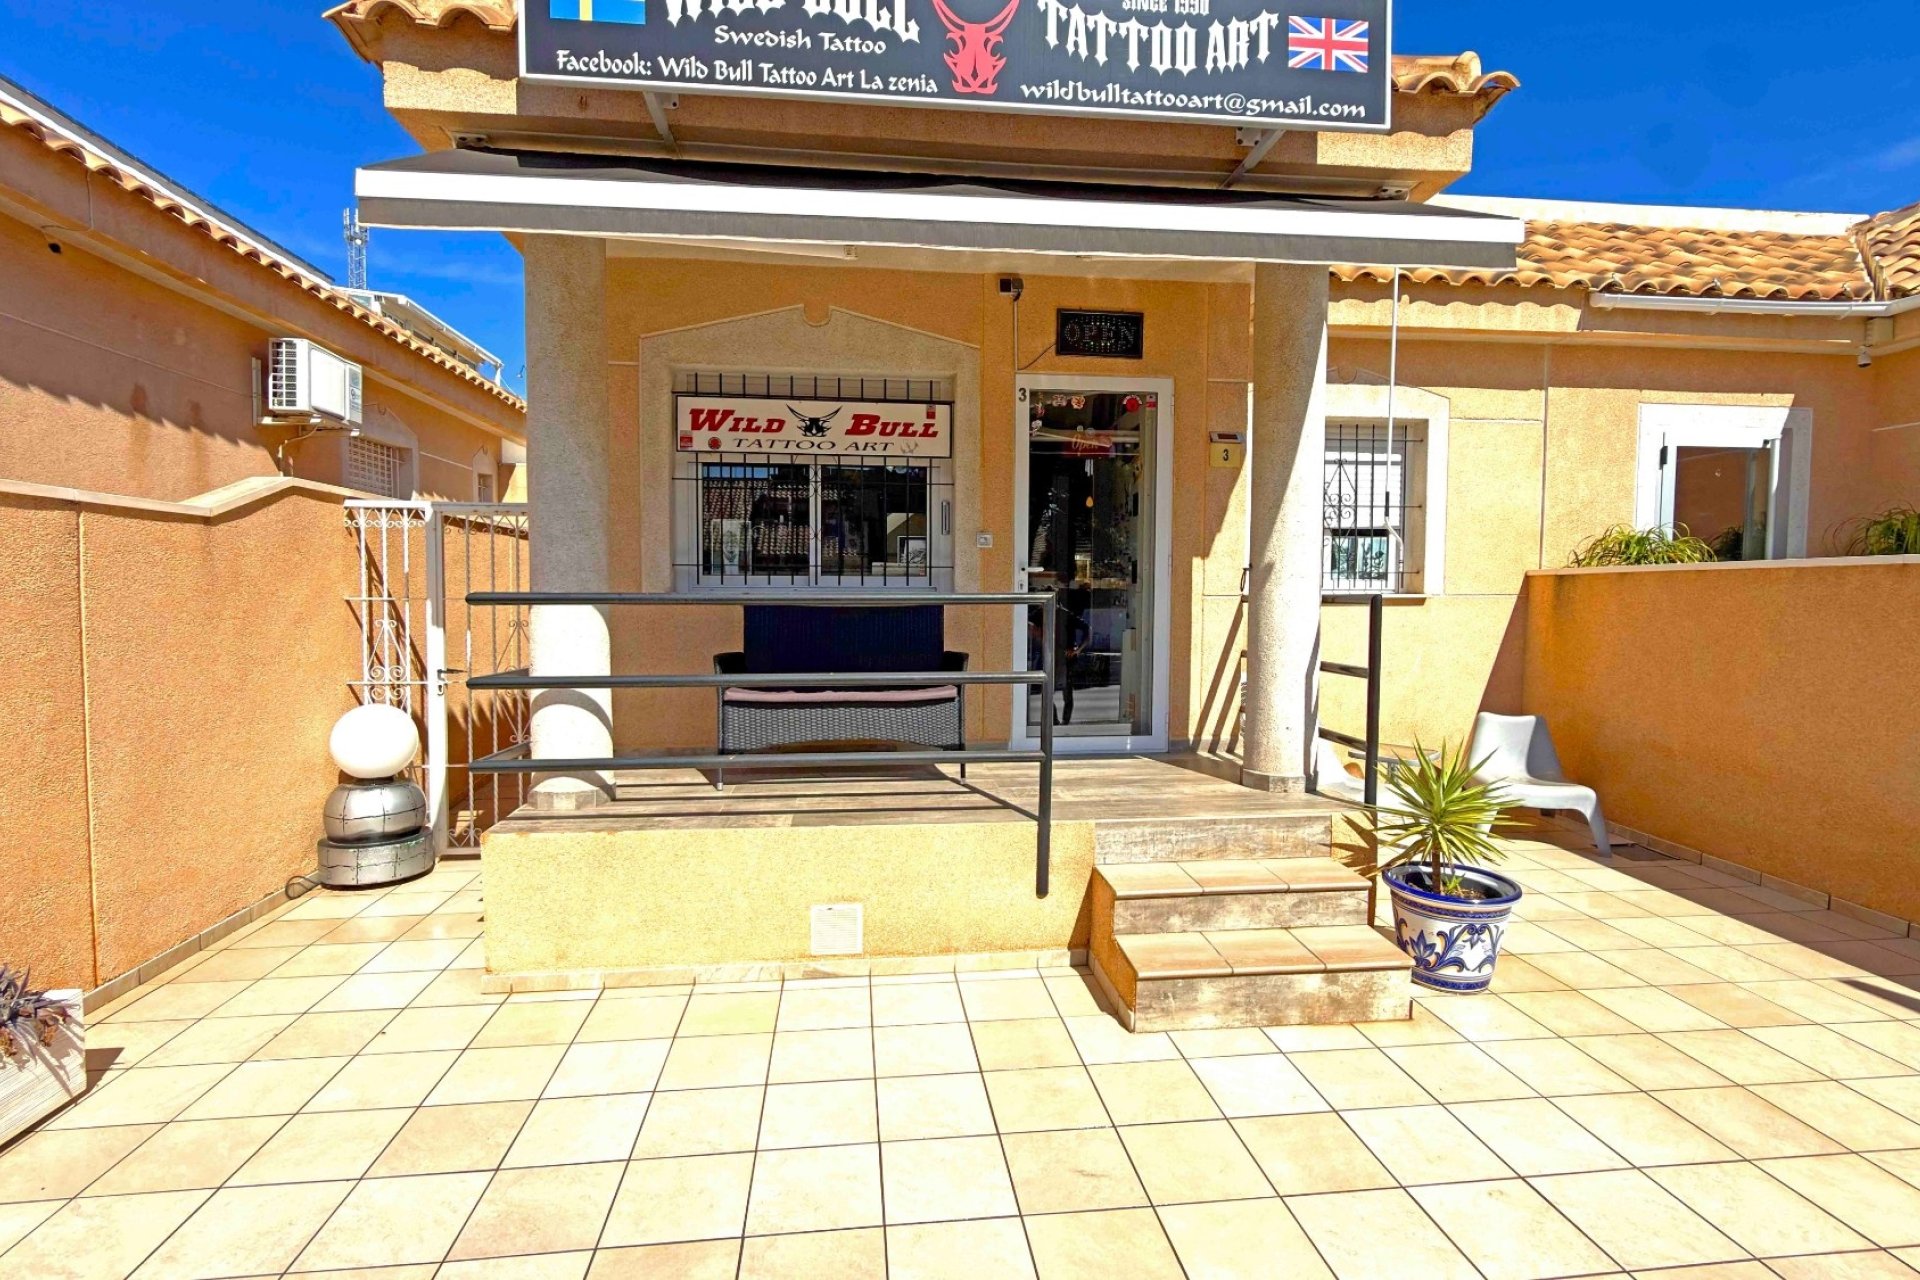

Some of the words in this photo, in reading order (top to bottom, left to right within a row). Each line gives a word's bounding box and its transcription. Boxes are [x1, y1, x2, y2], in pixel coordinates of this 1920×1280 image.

[714, 24, 812, 49] Swedish
[817, 32, 887, 54] Tattoo
[1037, 0, 1200, 76] TATTOO
[1204, 9, 1280, 74] ART
[556, 50, 652, 76] Facebook:
[657, 55, 708, 79] Wild
[714, 58, 753, 83] Bull
[758, 62, 818, 86] Tattoo
[820, 65, 854, 89] Art
[860, 68, 884, 91] La
[888, 73, 938, 93] zenia
[1019, 75, 1366, 118] wildbulltattooart@gmail.com
[1064, 321, 1137, 345] OPEN
[1018, 387, 1027, 402] 3
[689, 408, 786, 433] WILD
[844, 413, 939, 438] BULL
[732, 438, 836, 451] TATTOO
[844, 441, 895, 452] ART
[1223, 449, 1229, 461] 3
